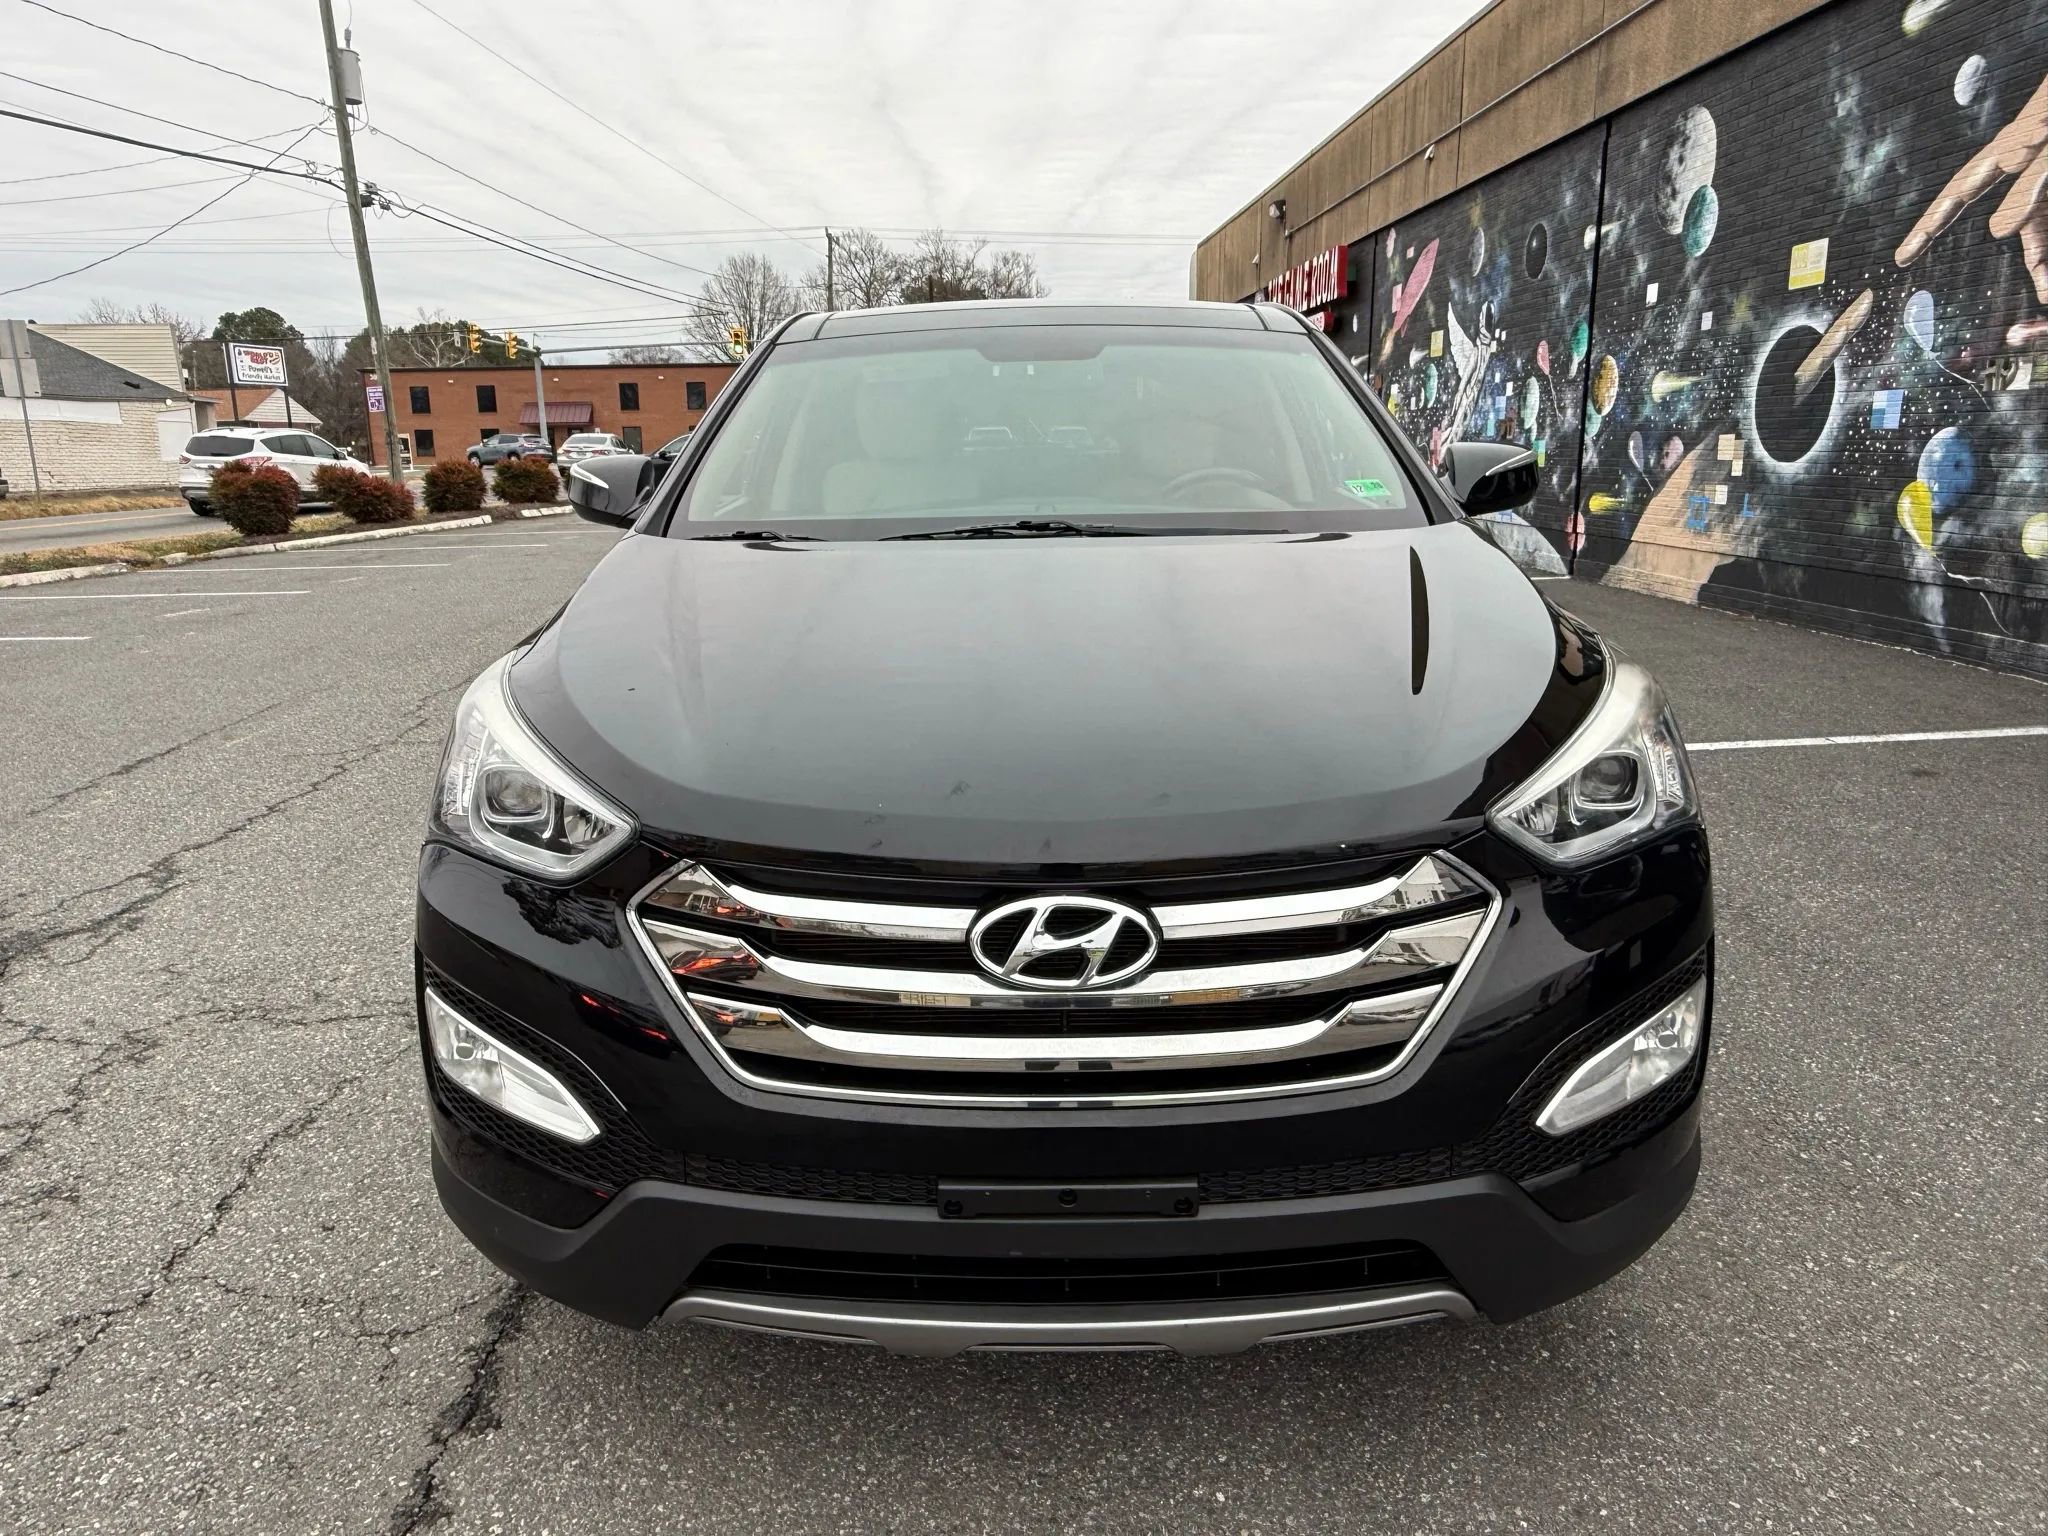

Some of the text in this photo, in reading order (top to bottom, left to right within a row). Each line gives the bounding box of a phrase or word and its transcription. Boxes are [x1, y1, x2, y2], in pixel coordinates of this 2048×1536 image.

[1284, 260, 1310, 313] GAME
[1309, 245, 1339, 309] ROOM
[248, 364, 273, 374] Powell's
[242, 372, 263, 381] Friendly
[1352, 485, 1364, 493] 12
